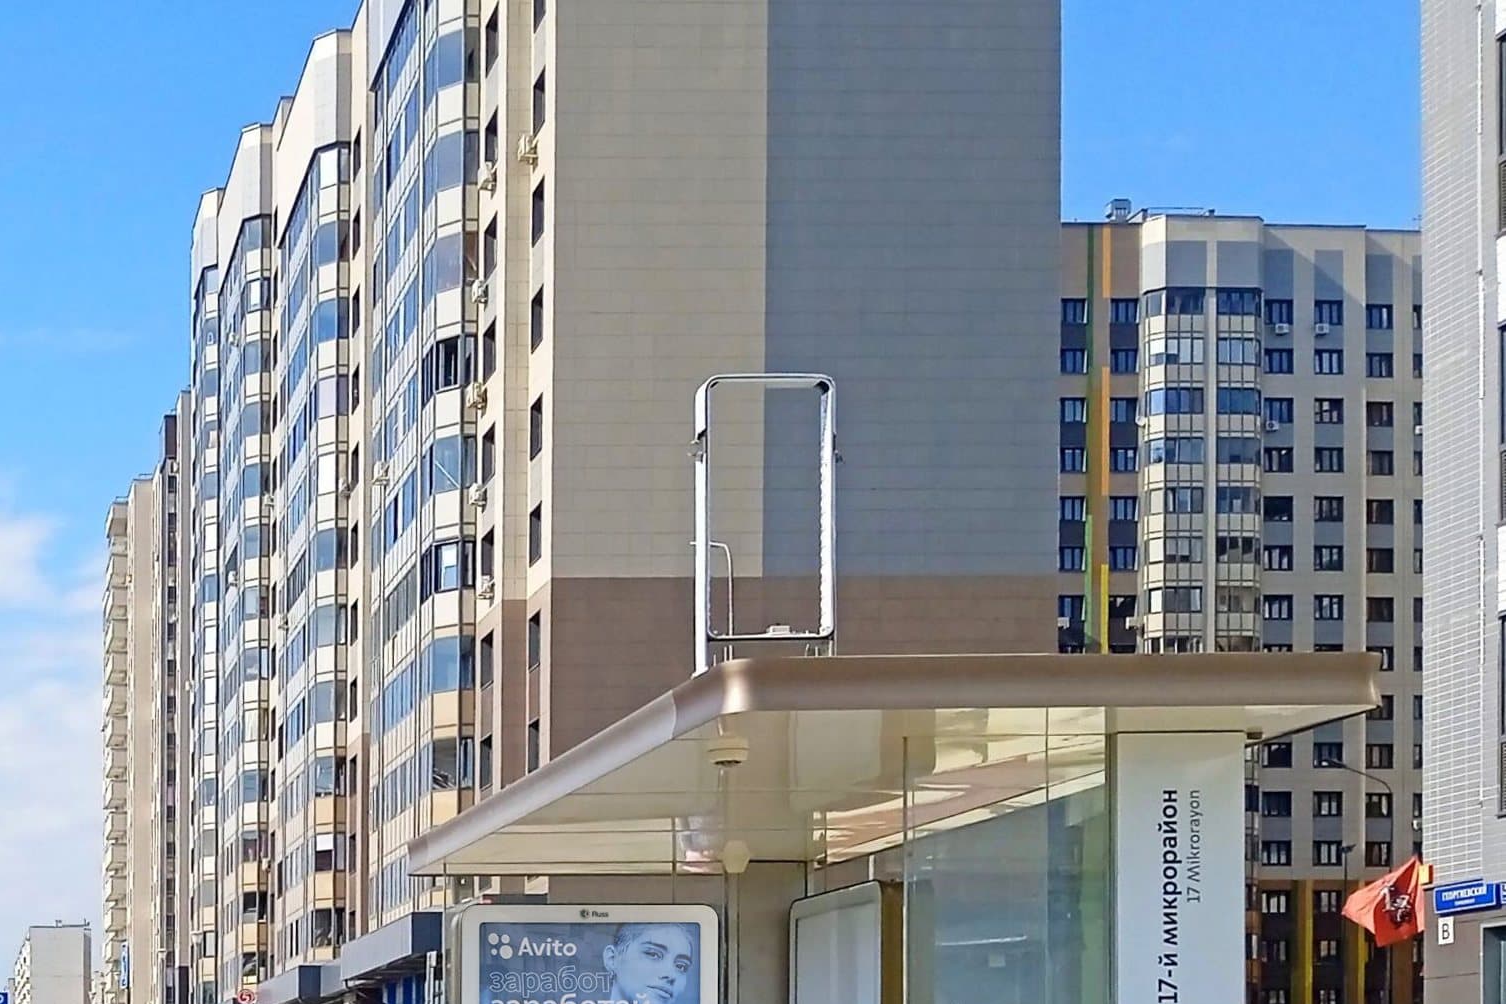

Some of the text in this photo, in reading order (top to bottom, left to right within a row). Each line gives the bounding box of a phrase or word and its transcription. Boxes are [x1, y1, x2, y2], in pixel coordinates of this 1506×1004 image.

[1158, 789, 1182, 1004] 17-й микрорайон
[1187, 790, 1204, 903] 17 Mikrorayon
[518, 937, 577, 957] Avito
